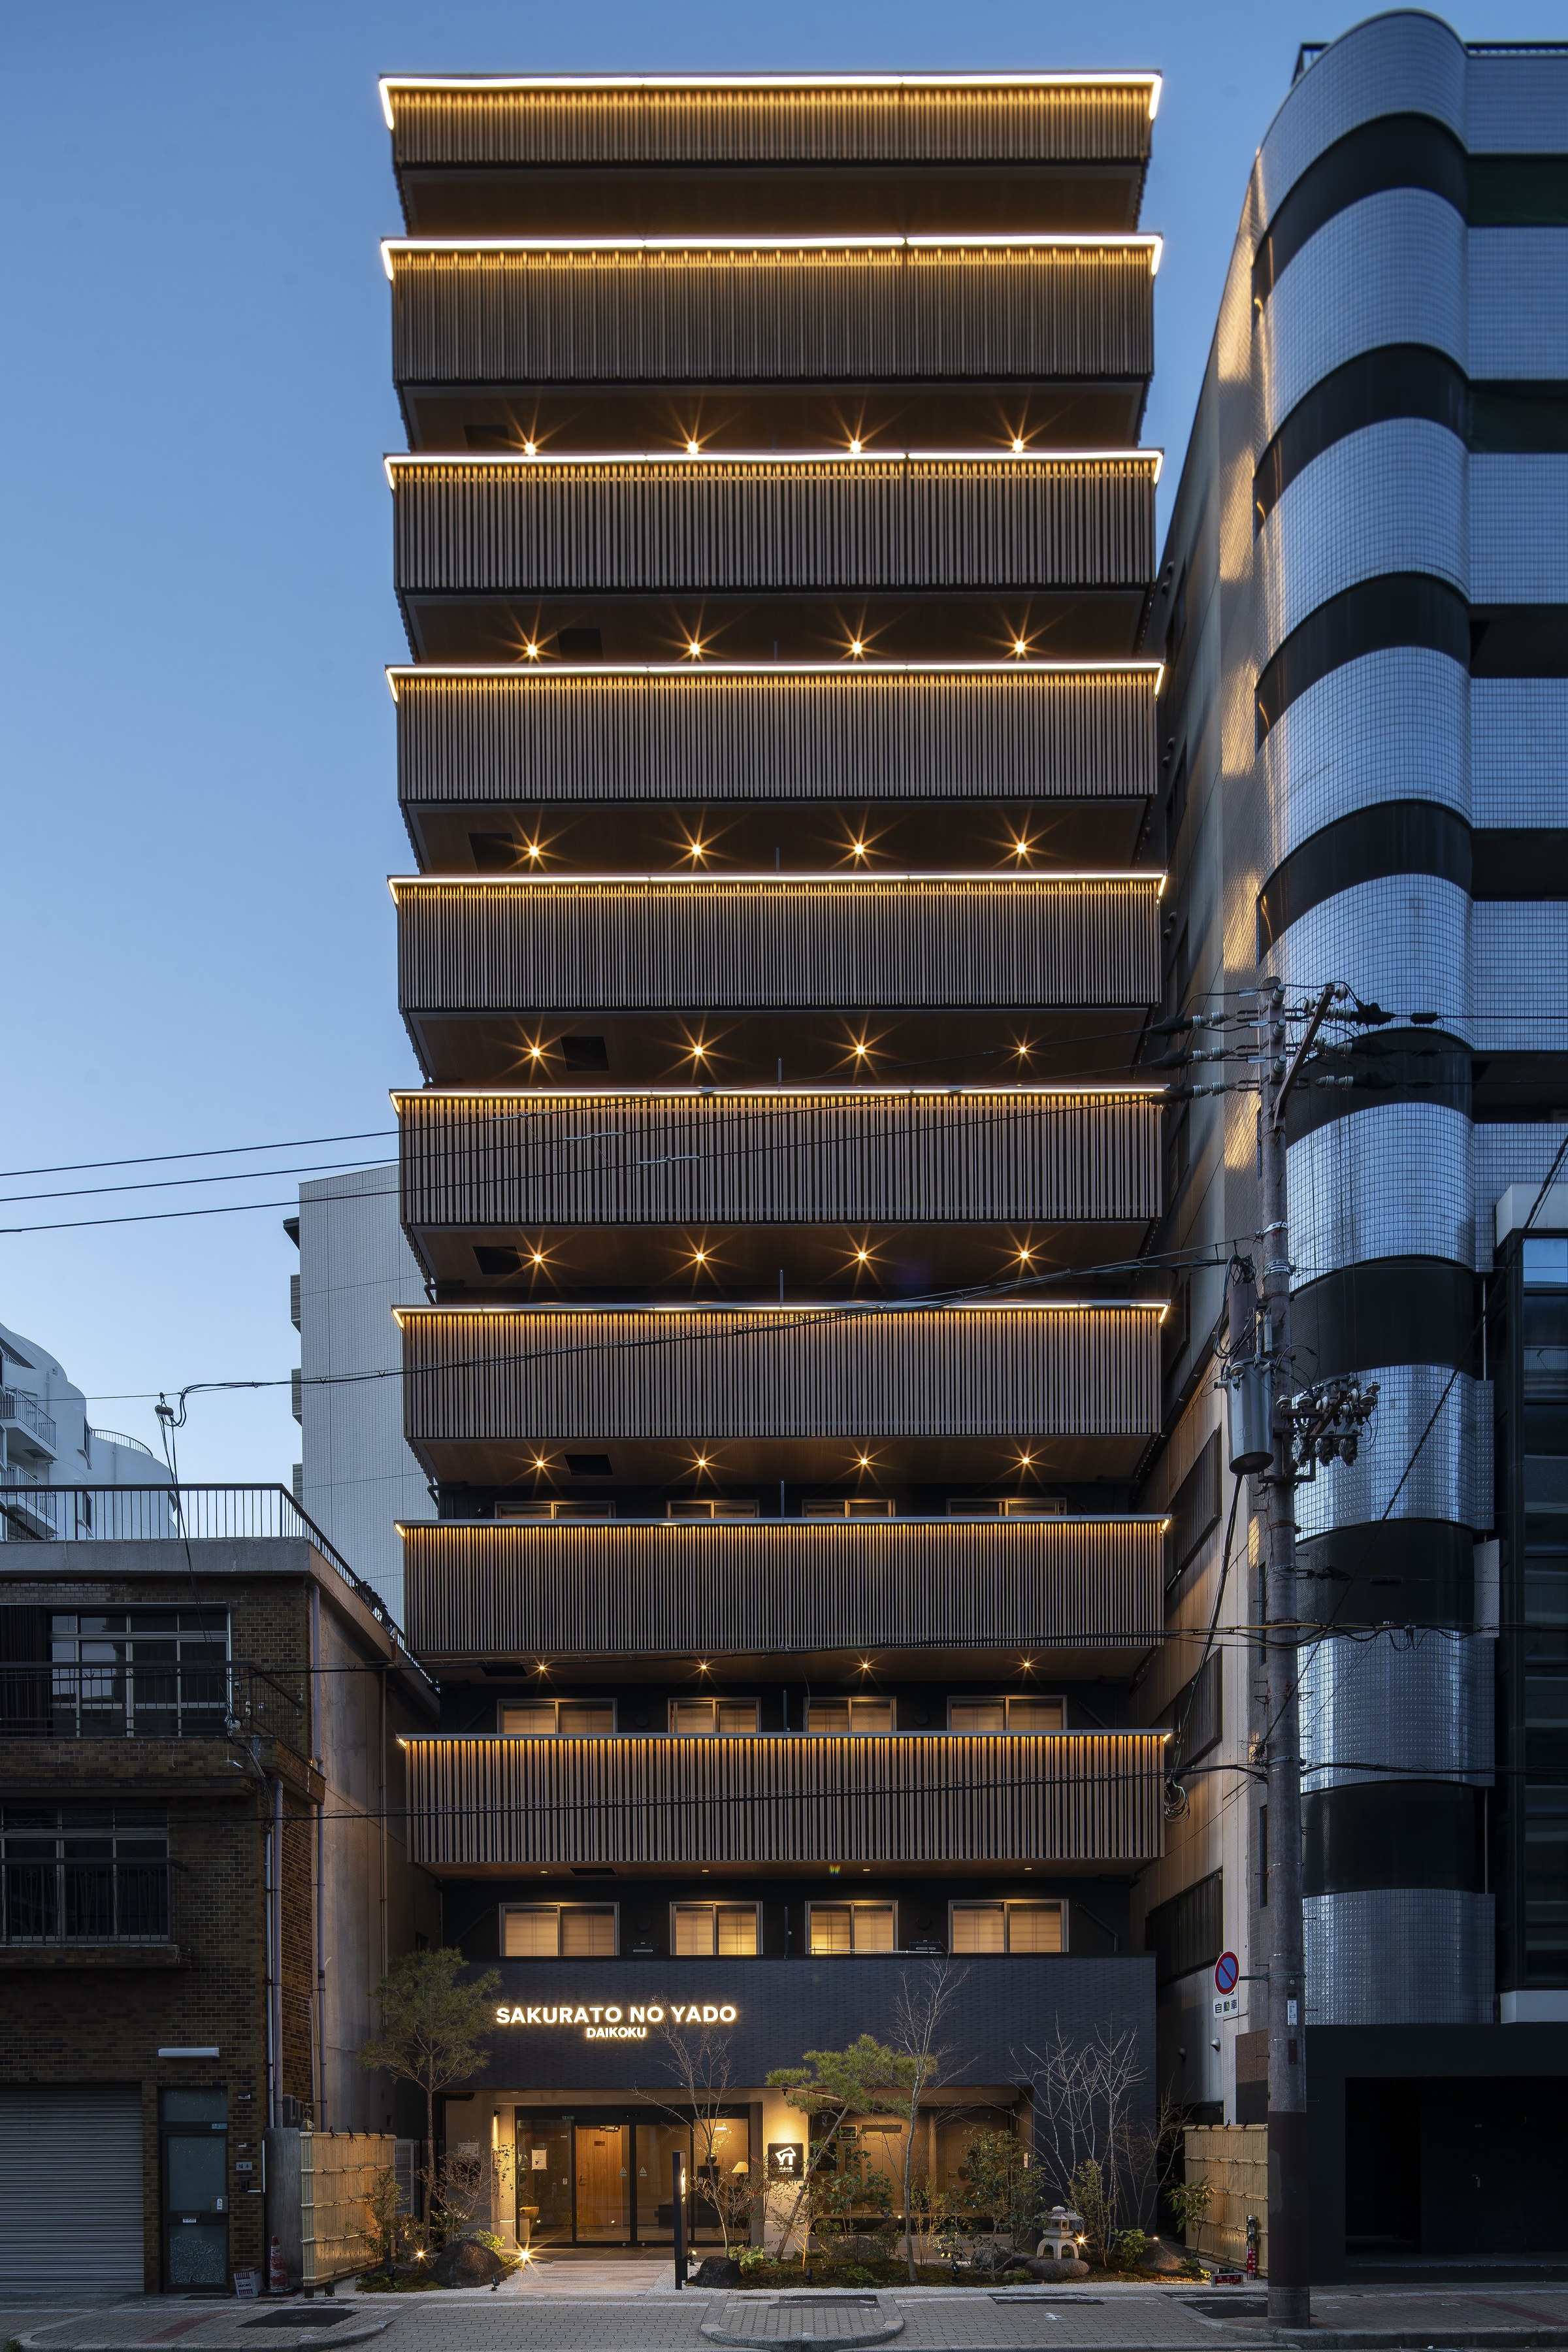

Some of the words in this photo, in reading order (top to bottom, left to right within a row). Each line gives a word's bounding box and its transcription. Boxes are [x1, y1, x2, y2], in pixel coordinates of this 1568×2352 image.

[1215, 1999, 1237, 2014] 自動車
[496, 2007, 623, 2024] SAKURATO
[630, 2006, 664, 2023] NO
[671, 2006, 736, 2023] YADO
[587, 2027, 646, 2038] DAIKOKU
